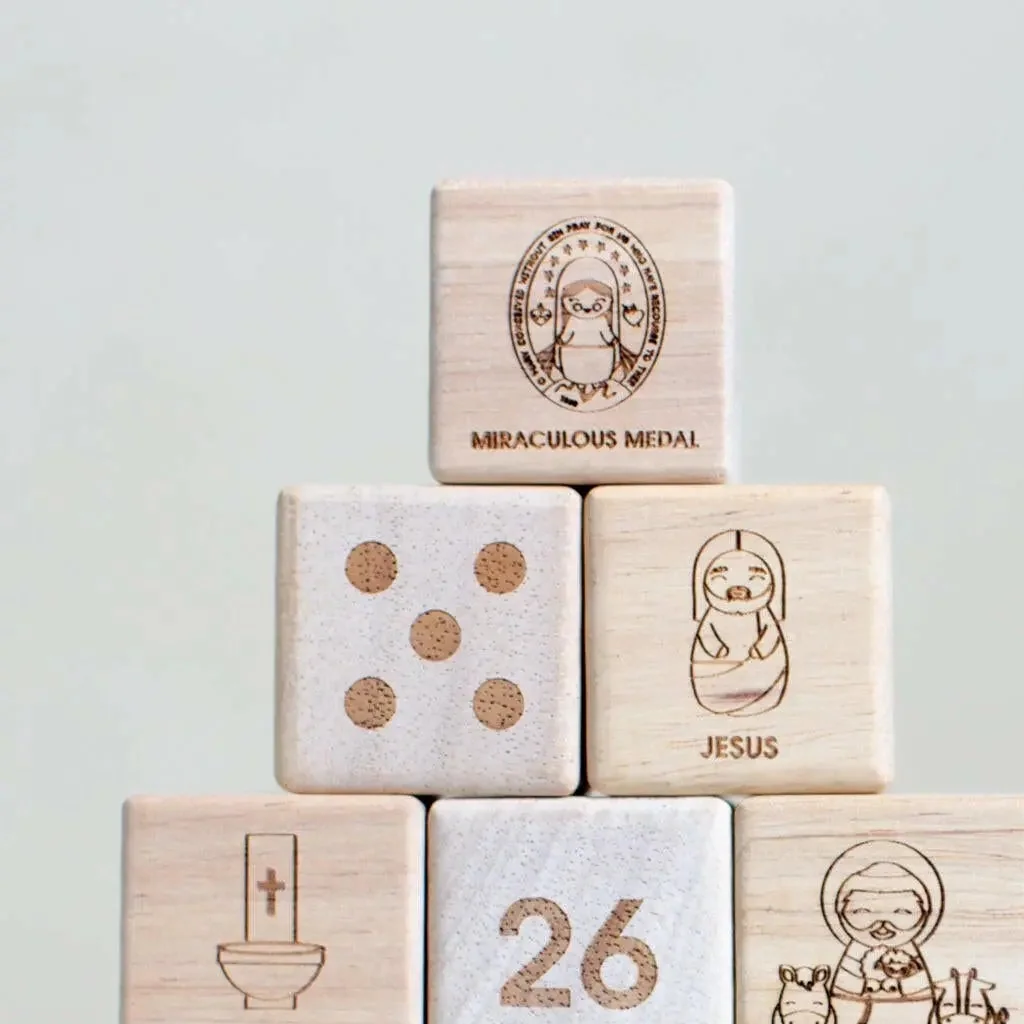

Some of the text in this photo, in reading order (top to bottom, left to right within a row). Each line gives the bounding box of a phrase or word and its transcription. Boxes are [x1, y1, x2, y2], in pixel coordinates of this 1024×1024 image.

[470, 429, 700, 450] MIRACULOUS MEDAL
[699, 735, 780, 761] JESUS
[498, 896, 659, 1011] 26
